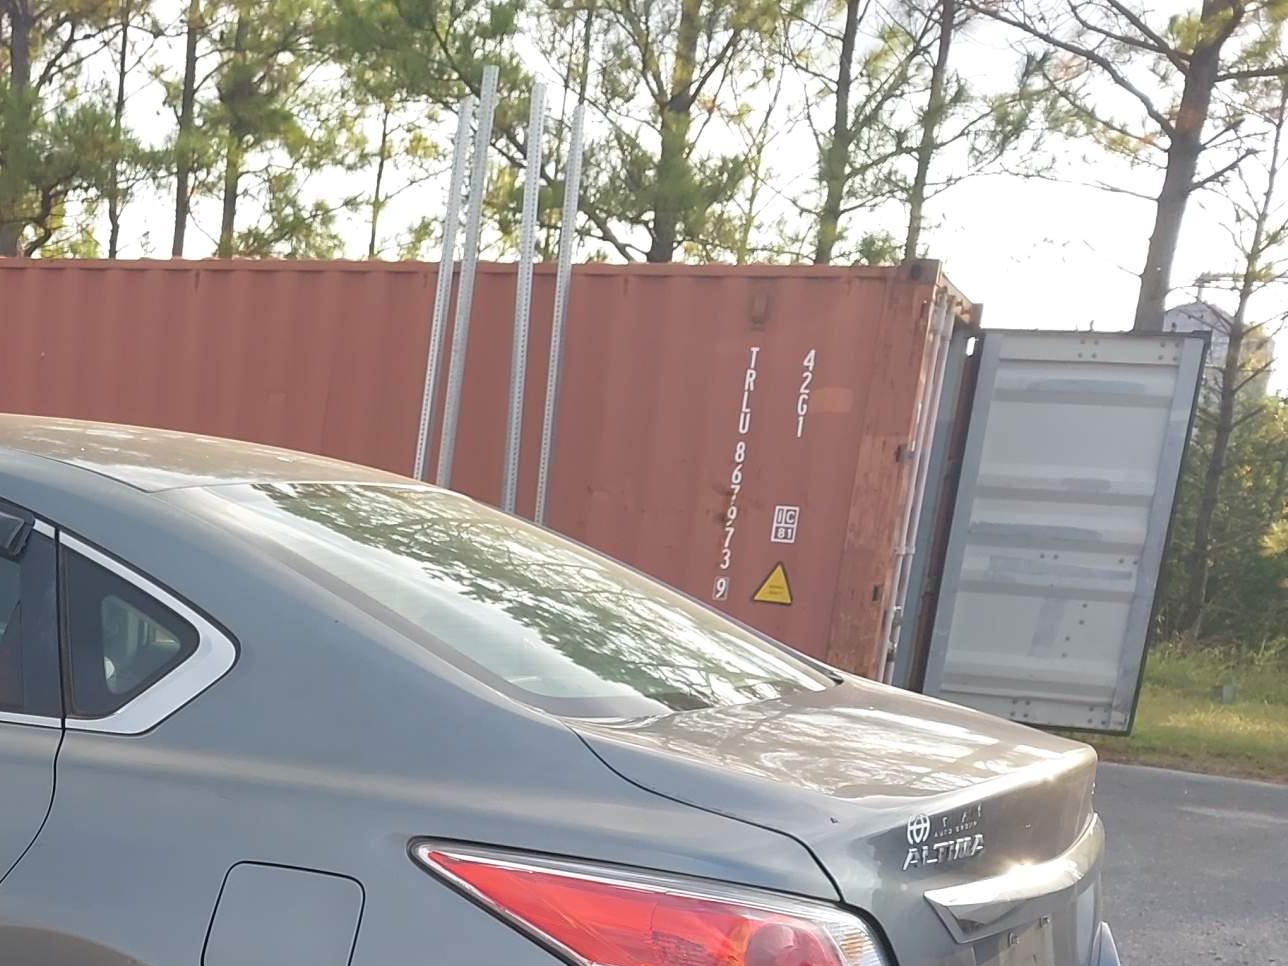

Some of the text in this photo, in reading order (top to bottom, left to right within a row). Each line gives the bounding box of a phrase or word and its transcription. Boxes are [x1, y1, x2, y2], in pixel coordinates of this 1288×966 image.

[739, 347, 760, 433] TRLU
[797, 349, 816, 438] 42G1
[903, 834, 983, 870] ALTIMA
